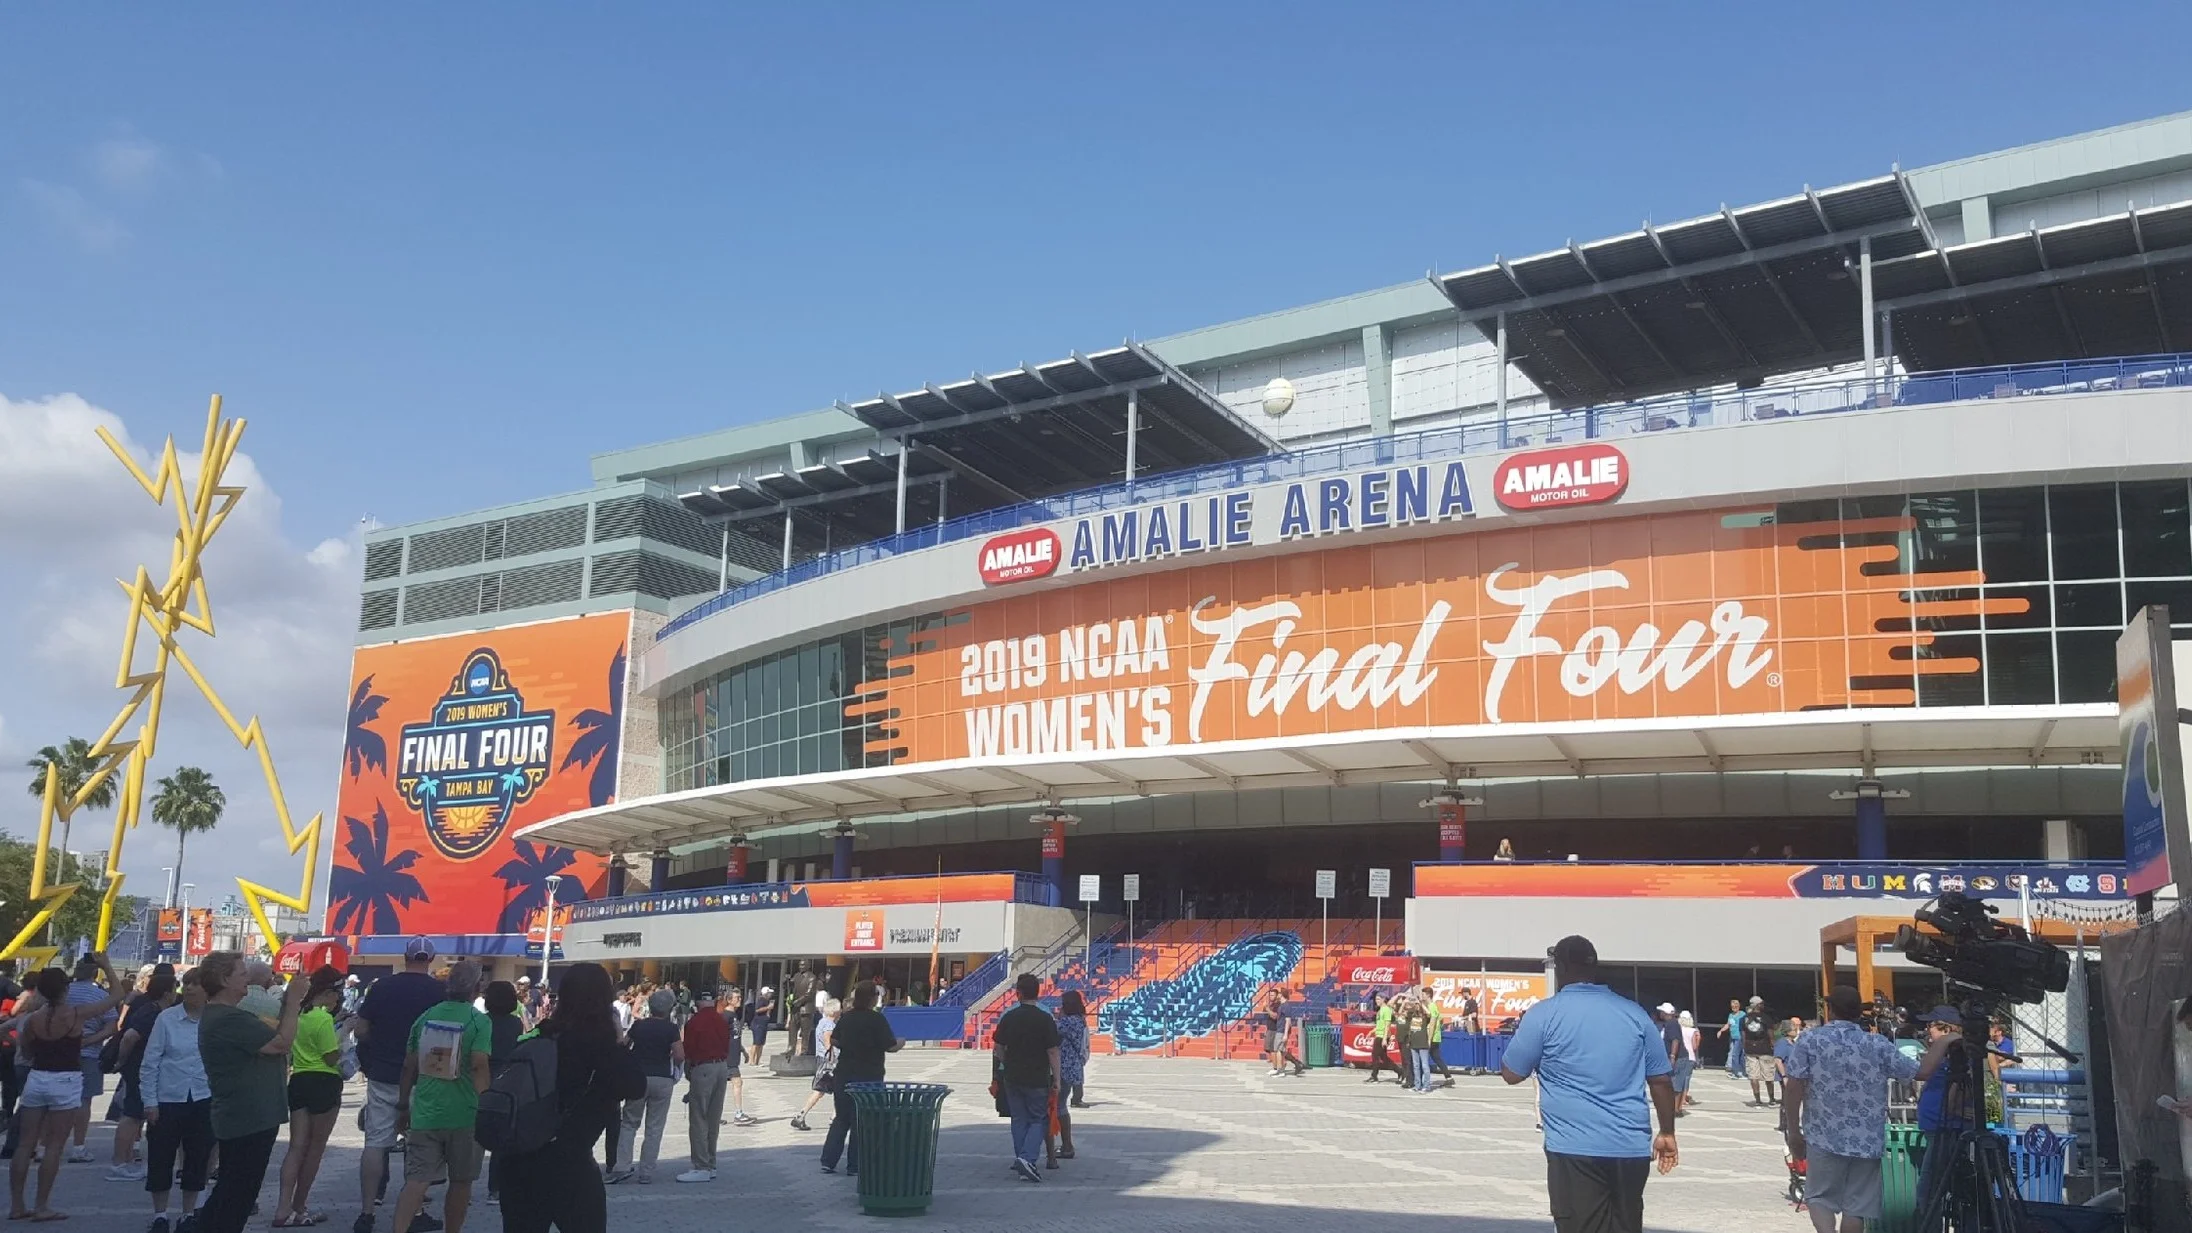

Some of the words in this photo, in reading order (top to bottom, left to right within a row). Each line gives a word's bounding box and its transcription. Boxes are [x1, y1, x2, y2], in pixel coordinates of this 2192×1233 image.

[1503, 455, 1618, 495] AMALIE
[1530, 491, 1568, 503] MOTOR
[1571, 488, 1589, 499] OIL
[1069, 492, 1253, 570] AMALIE
[1279, 460, 1476, 538] ARENA
[983, 538, 1053, 571] AMALIE
[1000, 566, 1022, 578] MOTOR
[1023, 565, 1035, 574] OIL
[960, 633, 1047, 697] 2019
[1060, 614, 1171, 682] NCAA
[1188, 595, 1452, 743] Final
[1482, 561, 1774, 724] Four
[471, 677, 489, 688] NCAA
[446, 706, 465, 722] 2019
[468, 701, 507, 720] WOMEN'S
[965, 685, 1172, 758] WOMEN'S
[401, 733, 469, 774] FINAL
[478, 725, 549, 768] FOUR
[446, 781, 473, 798] TAMPA
[476, 779, 494, 794] BAY
[851, 938, 876, 947] ENTRANCE
[1433, 977, 1455, 988] 2019
[1457, 977, 1481, 988] NCAA
[1485, 978, 1530, 989] WOMEN'S
